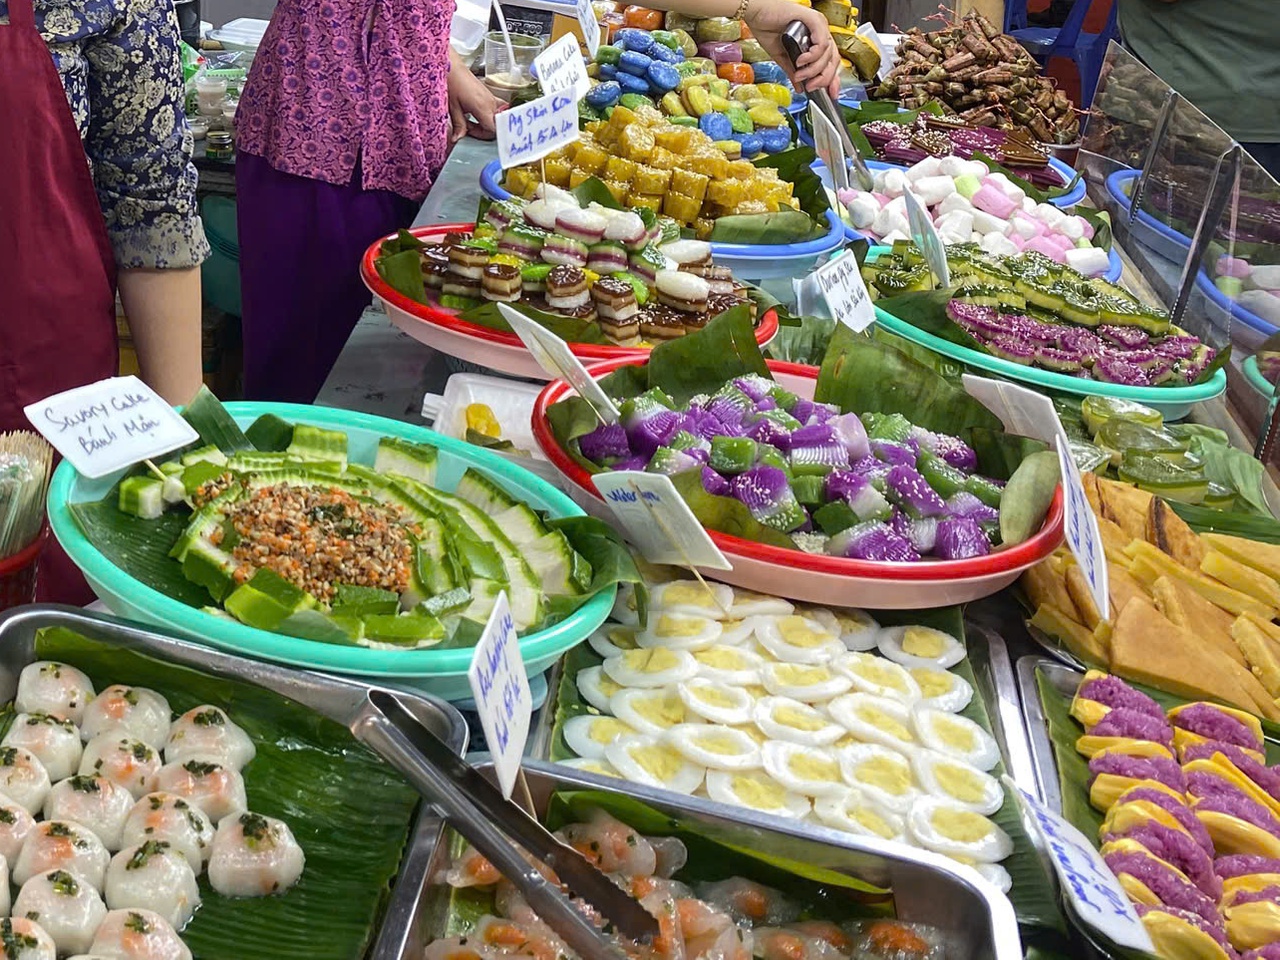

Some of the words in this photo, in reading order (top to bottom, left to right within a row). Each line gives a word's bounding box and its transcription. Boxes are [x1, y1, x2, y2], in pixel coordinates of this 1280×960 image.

[45, 402, 109, 433] Savory
[111, 393, 150, 413] Cake
[78, 425, 118, 455] Bánh
